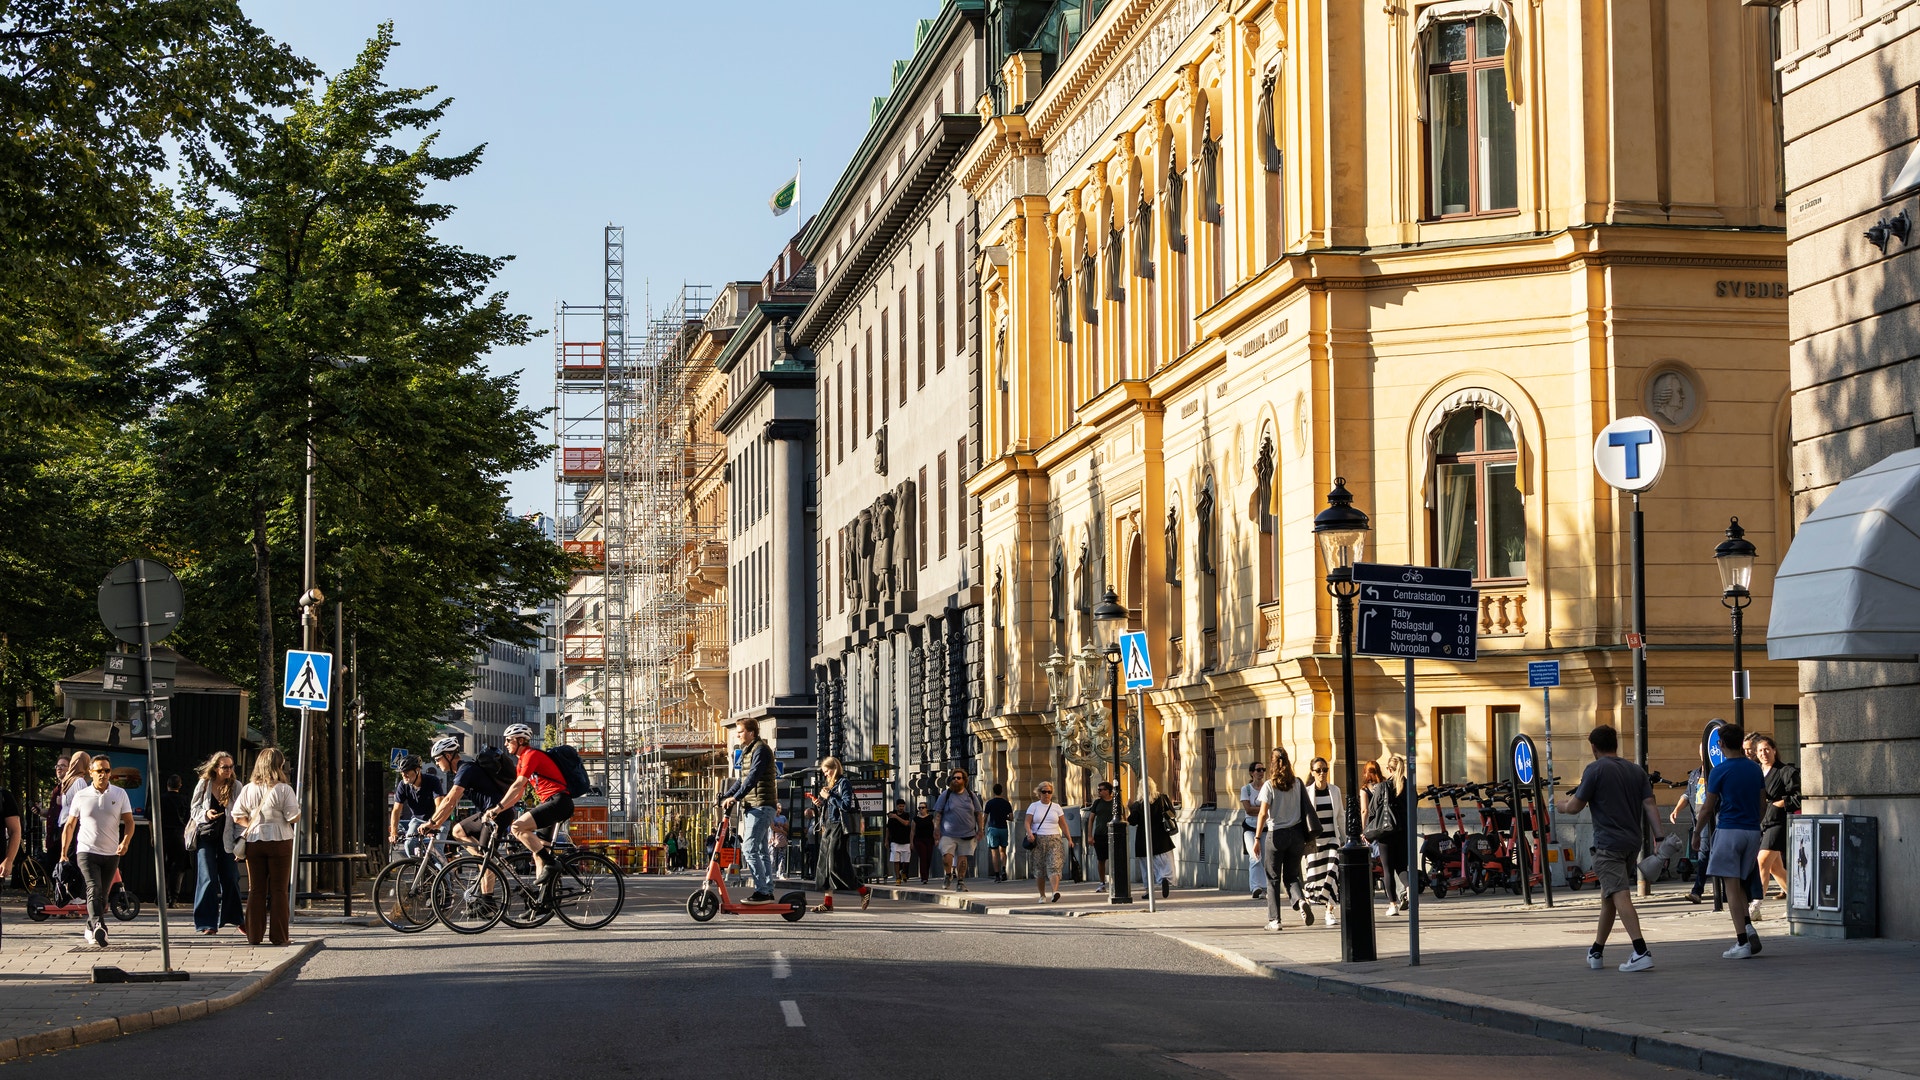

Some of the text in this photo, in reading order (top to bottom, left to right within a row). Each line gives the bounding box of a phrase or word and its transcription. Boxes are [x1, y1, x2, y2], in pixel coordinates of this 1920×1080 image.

[1716, 280, 1789, 299] SVEDE
[1608, 429, 1653, 480] T
[1393, 589, 1471, 604] Centralstation 1,1
[1392, 608, 1468, 622] Täby 14
[1391, 620, 1470, 634] Roslagstull 3,0
[1390, 631, 1470, 645] Stureplan 0,8
[1390, 642, 1469, 656] Nybroplan 0,3
